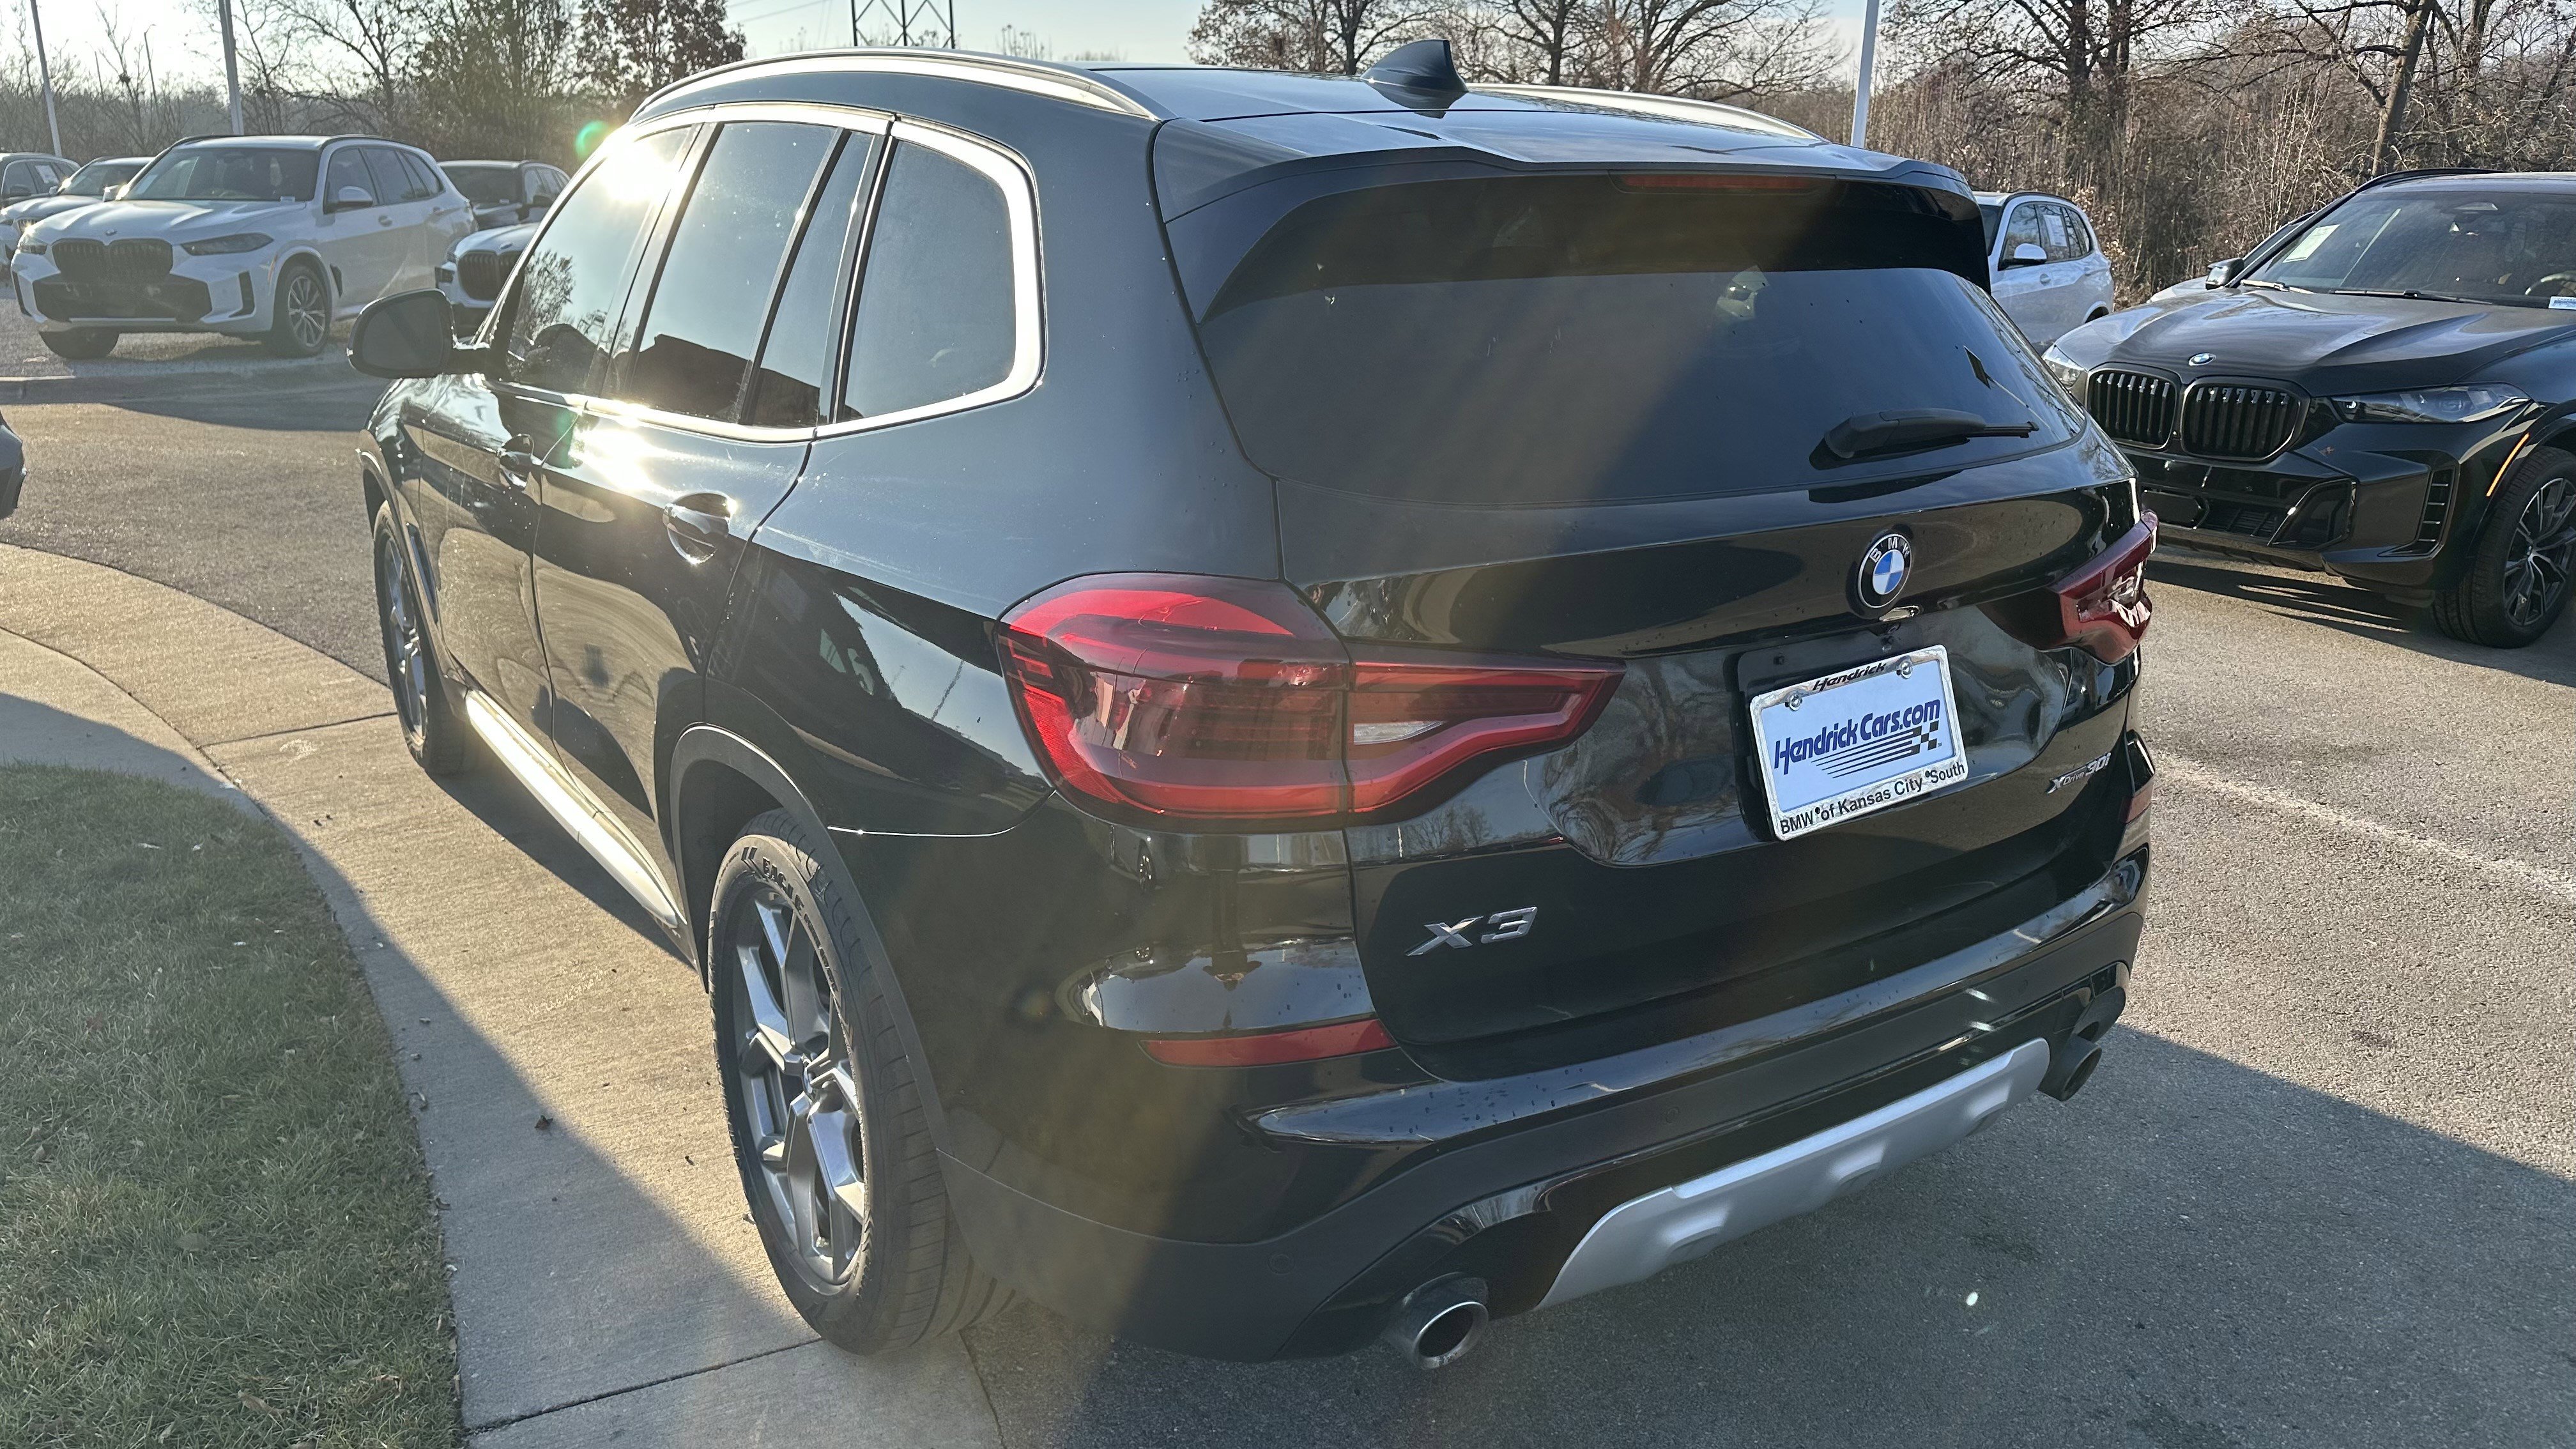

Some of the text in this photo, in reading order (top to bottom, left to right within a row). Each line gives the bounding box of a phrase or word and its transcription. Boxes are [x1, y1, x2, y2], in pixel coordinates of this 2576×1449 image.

[1869, 537, 1910, 563] BMW
[1813, 662, 1887, 691] Hendrick
[1779, 762, 1965, 834] BMW of Kansas City South
[1405, 905, 1538, 956] X3
